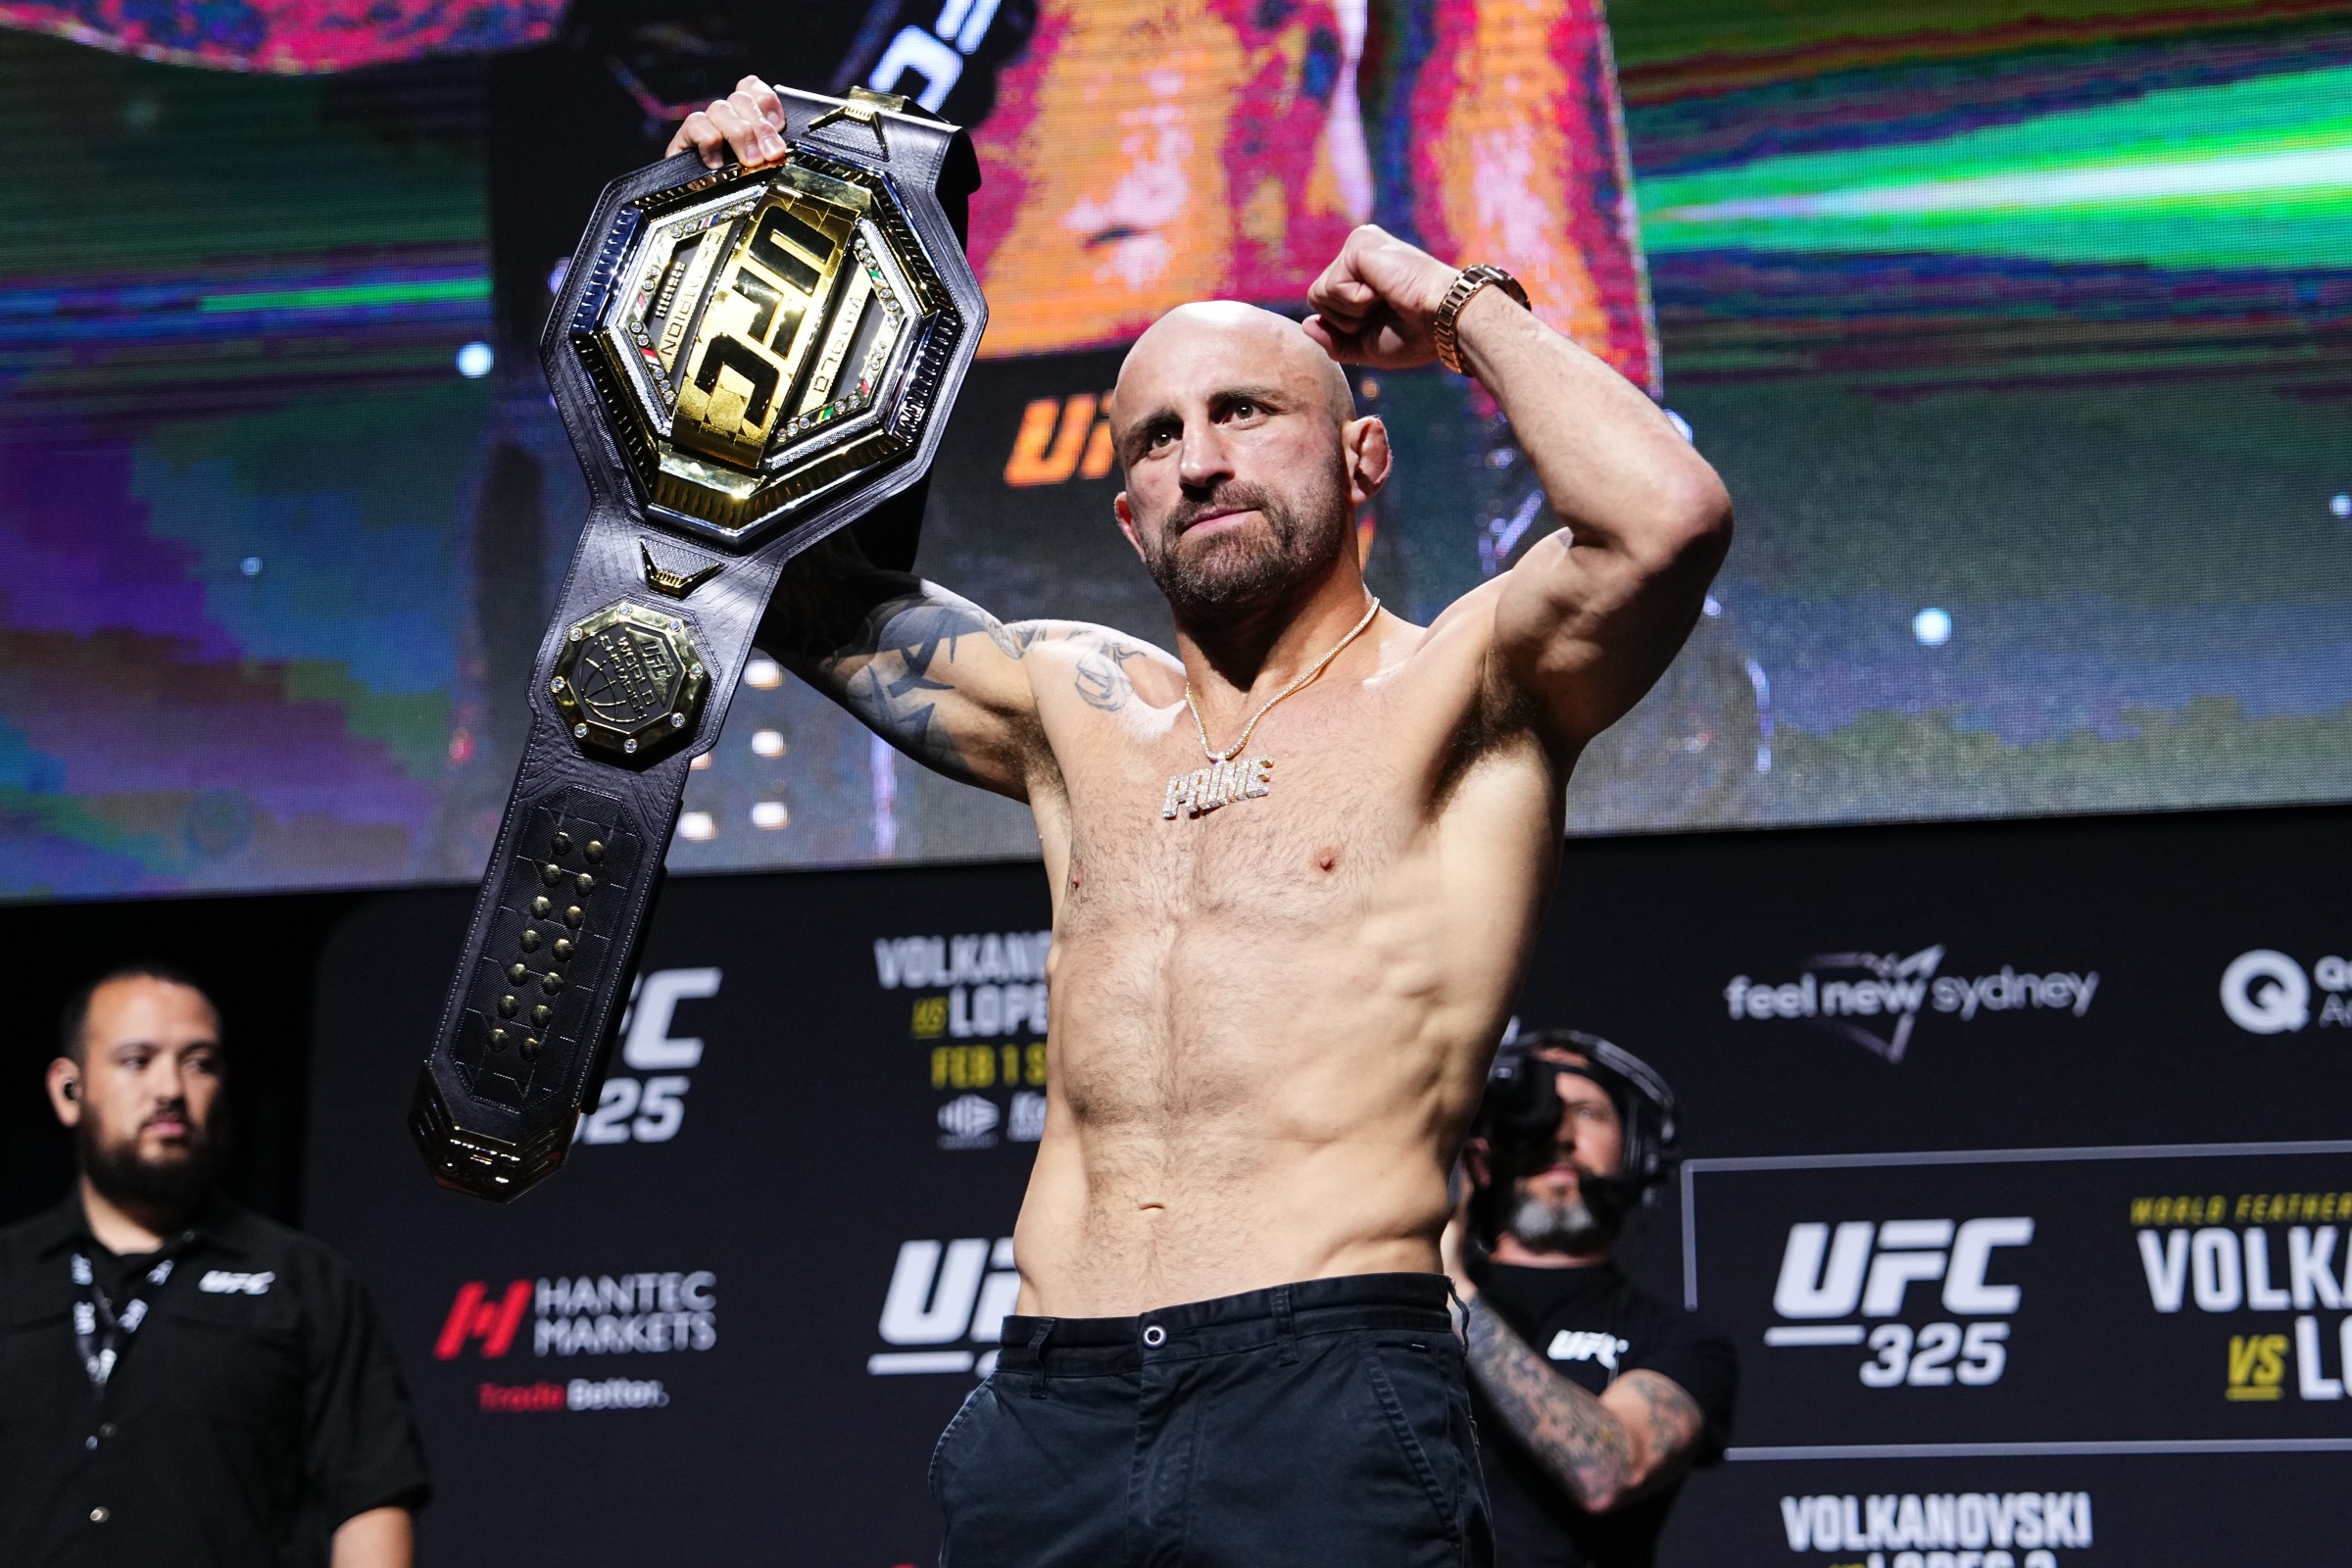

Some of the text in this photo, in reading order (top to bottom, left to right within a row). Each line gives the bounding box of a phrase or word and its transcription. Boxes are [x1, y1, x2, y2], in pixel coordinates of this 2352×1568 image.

[693, 205, 836, 429] UFC
[599, 634, 648, 720] CHAMPION
[616, 636, 658, 707] WORLD
[639, 640, 672, 681] UFC
[619, 966, 724, 1070] C
[1724, 964, 2101, 1022] feel new sydney
[571, 1075, 691, 1145] 25
[534, 1270, 718, 1317] HANTEC
[1772, 1215, 2036, 1320] UFC
[2136, 1225, 2352, 1313] VOLK
[533, 1310, 718, 1358] MARKETS
[1858, 1321, 2011, 1389] 325
[2225, 1313, 2352, 1401] VS L
[1779, 1491, 2094, 1553] VOLKANOVSKI
